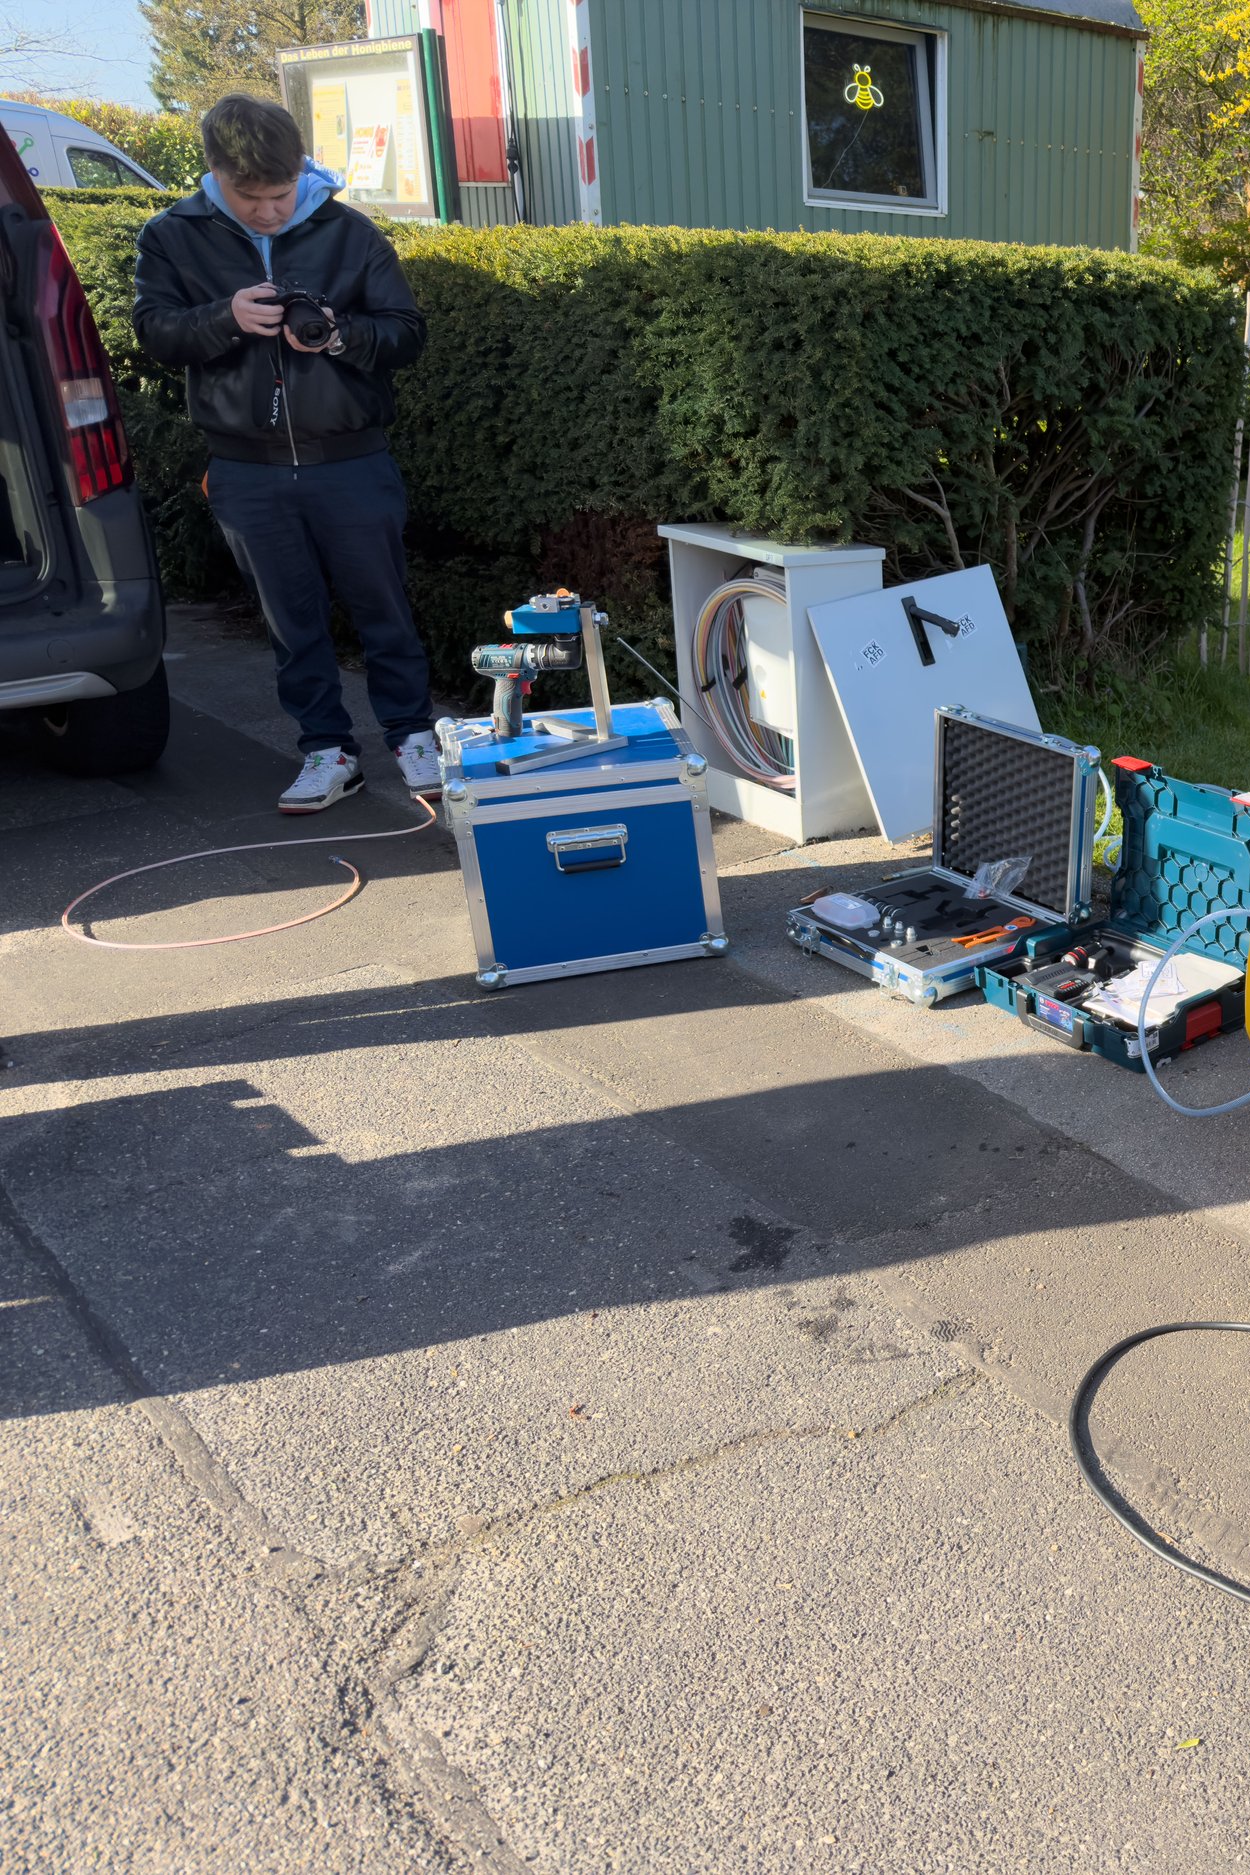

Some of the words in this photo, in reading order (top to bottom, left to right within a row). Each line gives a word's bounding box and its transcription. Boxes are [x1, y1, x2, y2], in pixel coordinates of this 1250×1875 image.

[280, 51, 299, 63] Das
[300, 48, 331, 61] Leben
[332, 45, 348, 58] der
[351, 40, 412, 56] Honigbiene
[270, 387, 281, 427] SONY
[961, 621, 975, 637] AFD
[863, 641, 880, 659] FCK
[868, 648, 885, 664] AFD
